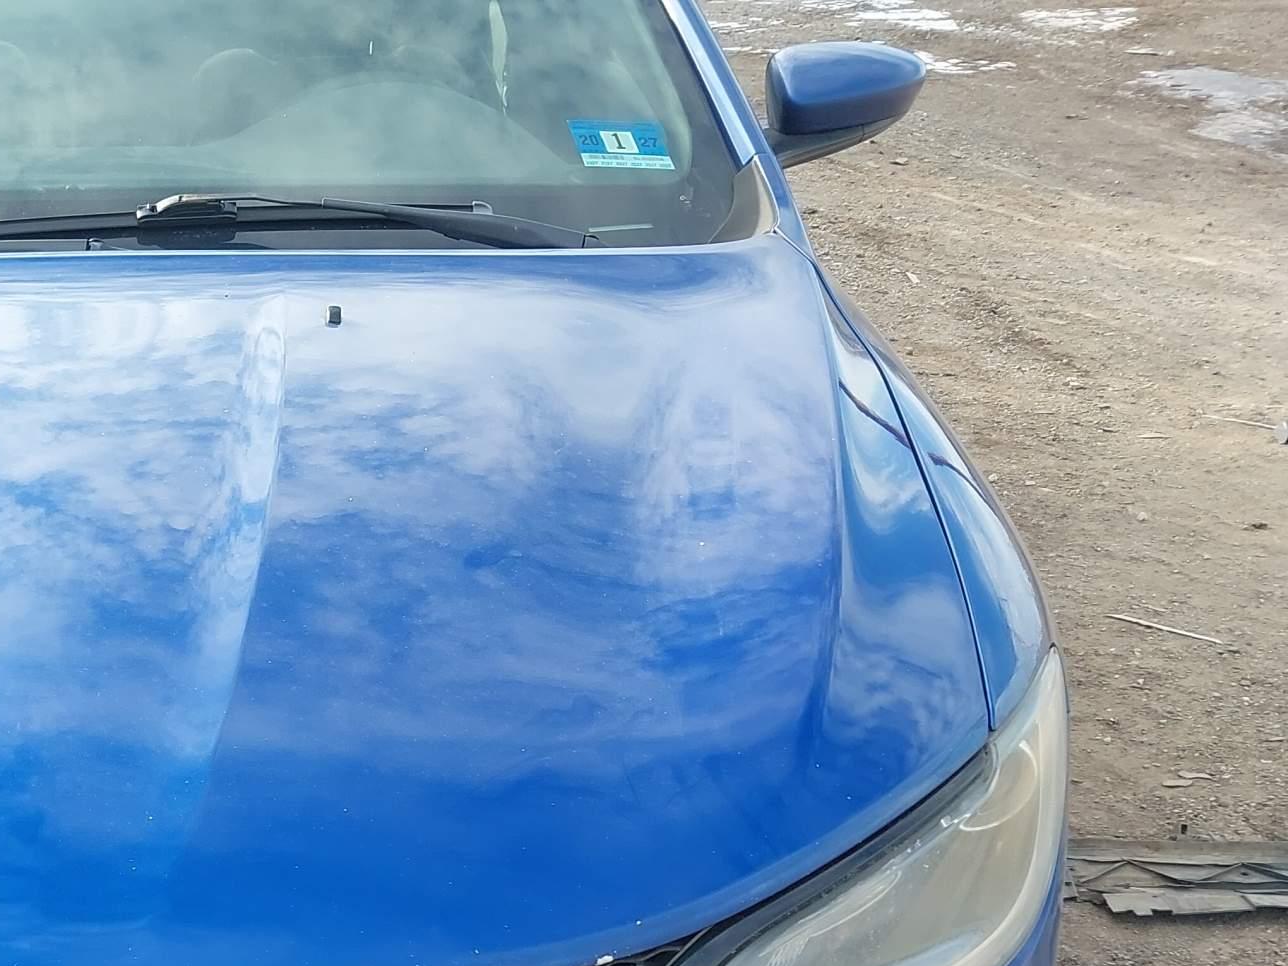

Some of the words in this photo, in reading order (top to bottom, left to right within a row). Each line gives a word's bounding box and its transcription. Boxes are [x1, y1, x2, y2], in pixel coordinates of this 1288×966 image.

[579, 134, 599, 146] 20
[611, 132, 626, 149] 1
[638, 137, 658, 148] 27
